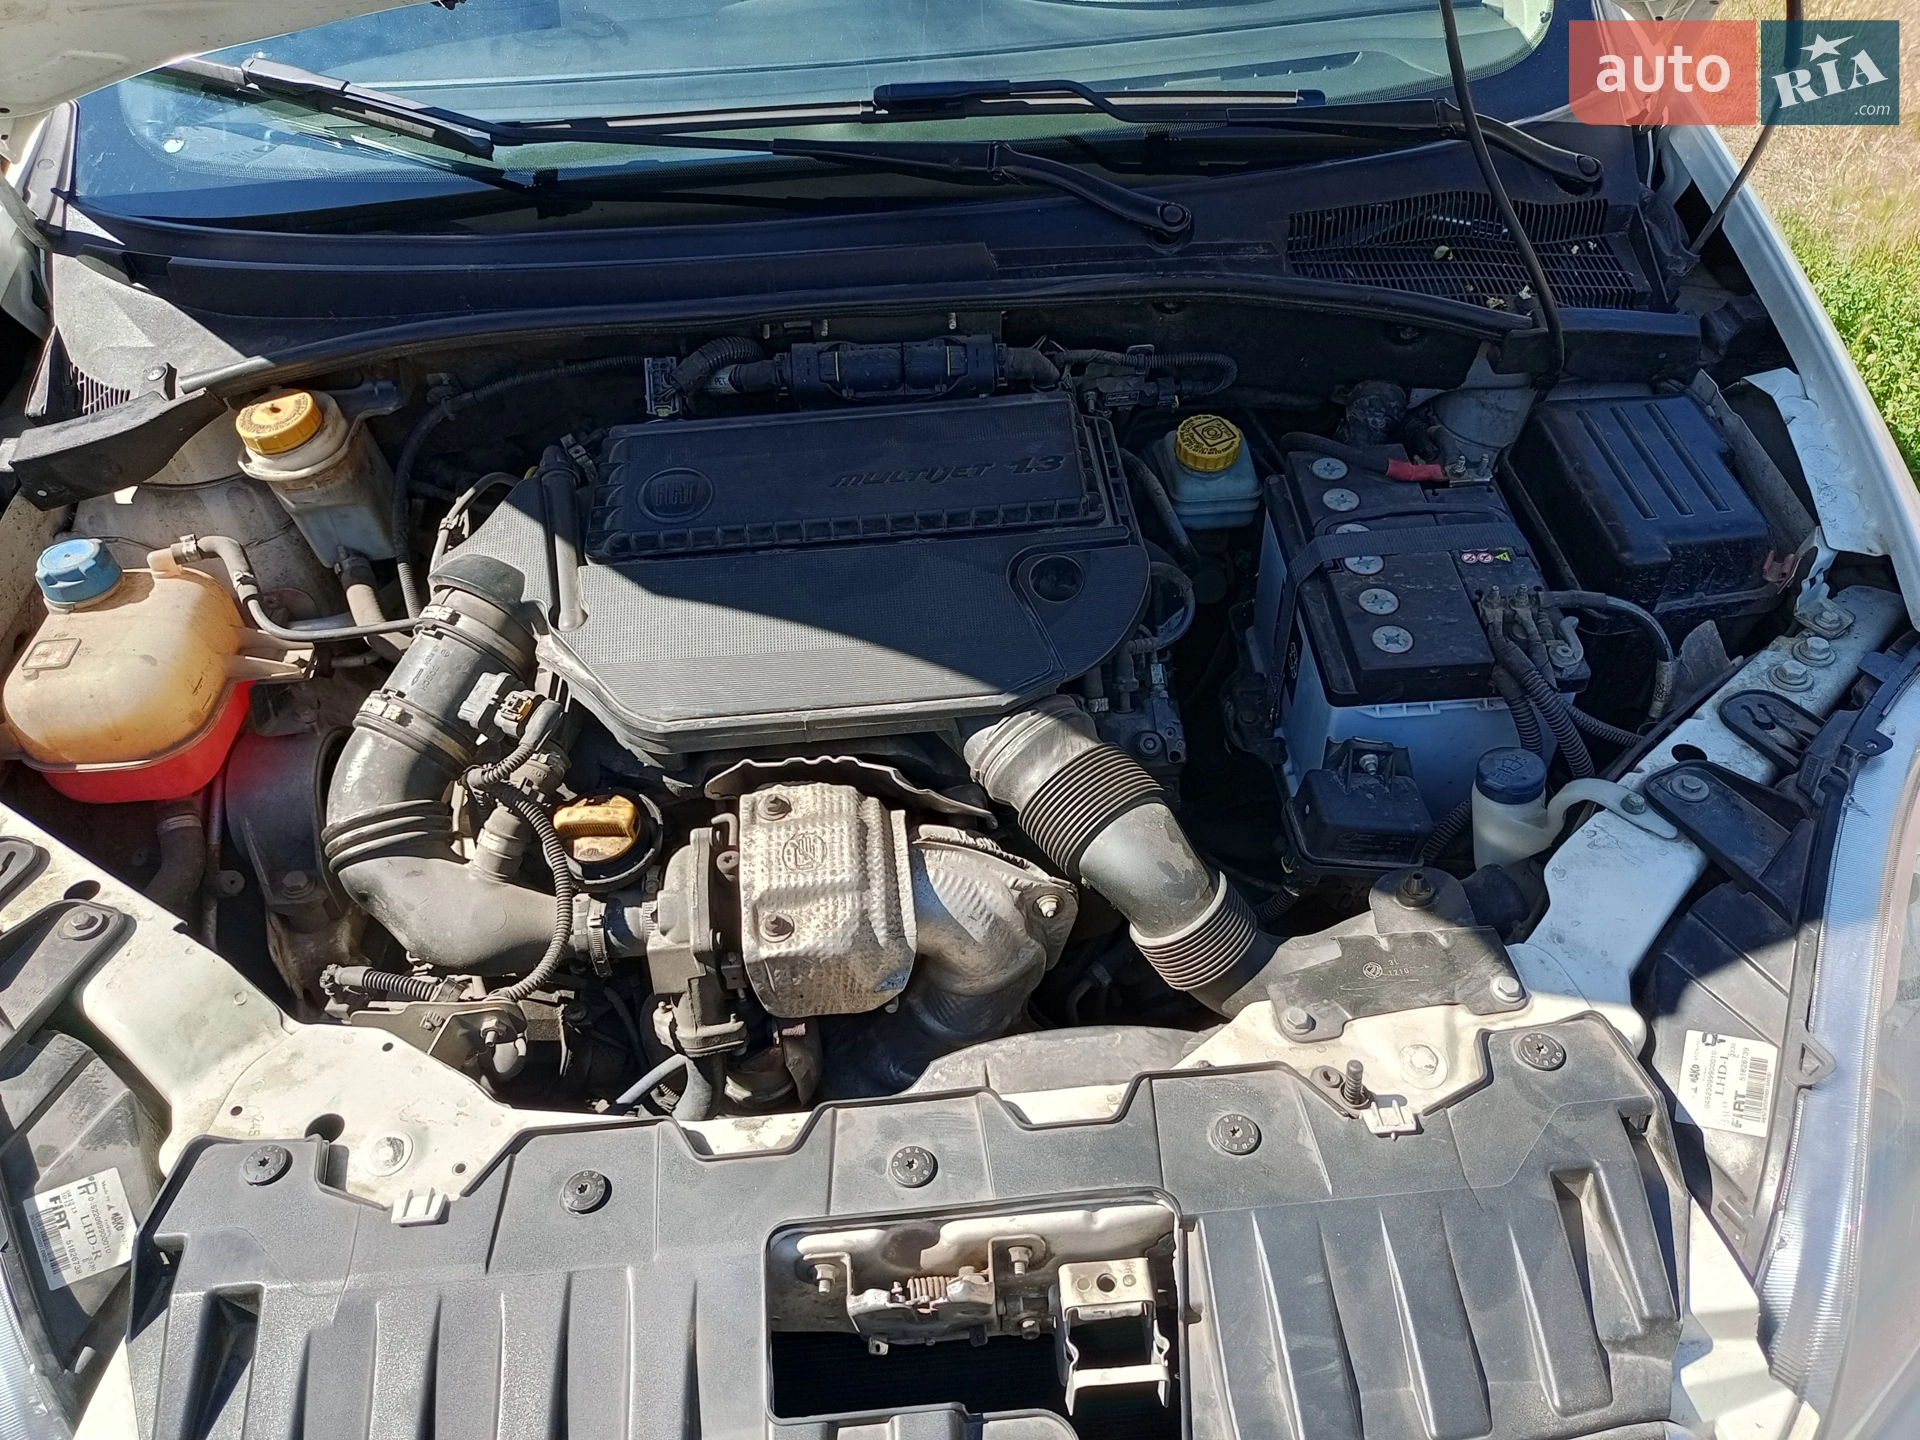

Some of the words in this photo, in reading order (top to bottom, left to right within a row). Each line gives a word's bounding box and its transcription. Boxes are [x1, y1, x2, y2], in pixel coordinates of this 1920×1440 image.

[656, 482, 693, 505] FIAT
[1730, 1089, 1746, 1128] FIAT
[49, 1194, 71, 1233] FIAT
